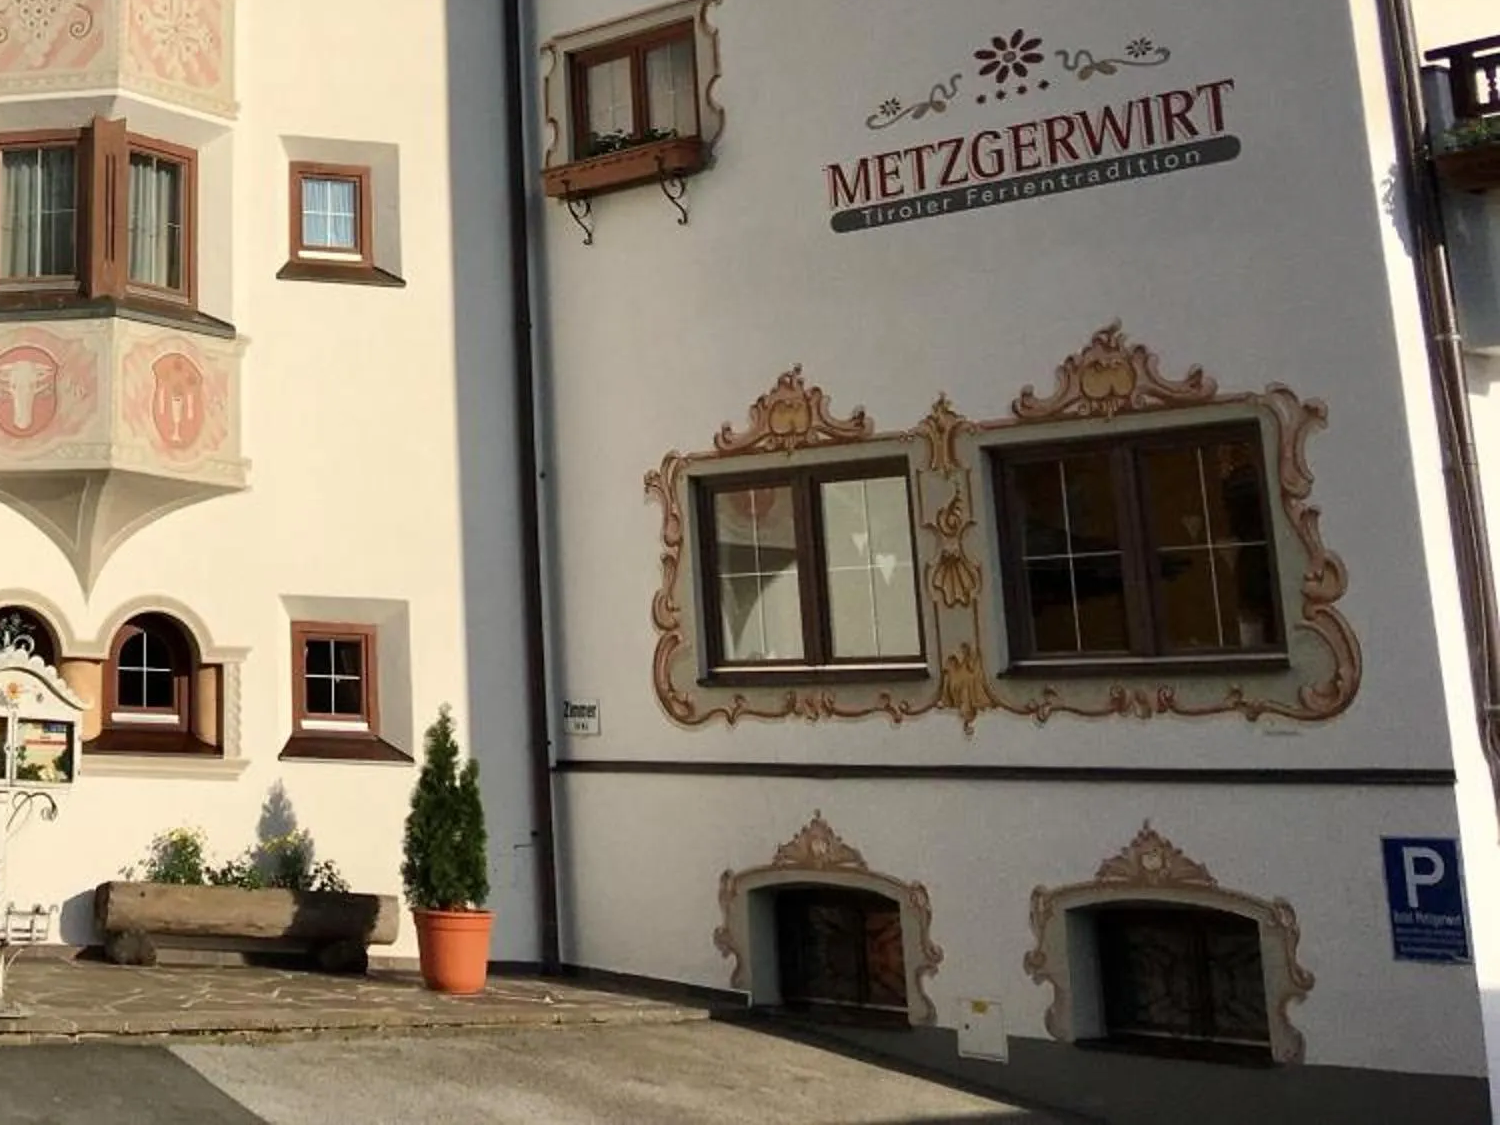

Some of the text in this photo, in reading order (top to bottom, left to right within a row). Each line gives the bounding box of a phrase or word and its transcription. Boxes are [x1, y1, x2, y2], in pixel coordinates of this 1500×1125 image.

[824, 78, 1235, 208] METZGERWIRT
[860, 150, 1202, 225] Tiroler Ferientradition
[1402, 845, 1445, 908] P
